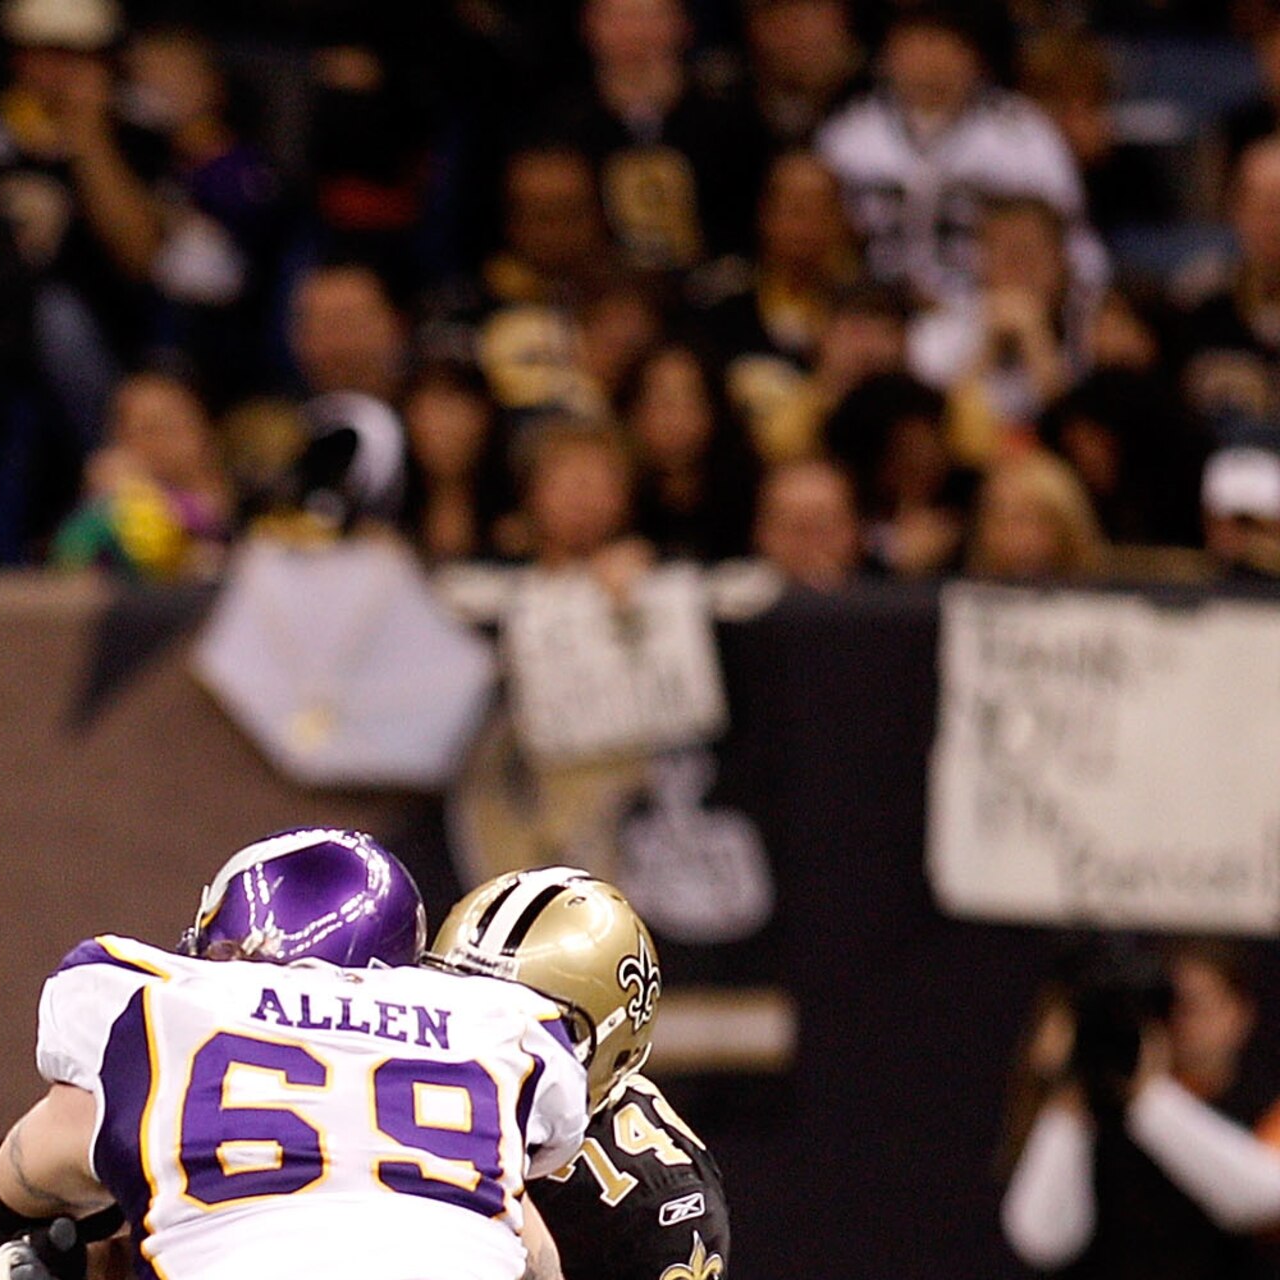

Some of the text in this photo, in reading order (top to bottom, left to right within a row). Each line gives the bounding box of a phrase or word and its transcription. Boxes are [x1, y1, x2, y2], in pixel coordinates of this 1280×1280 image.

[249, 986, 452, 1050] ALLEN
[177, 1027, 507, 1218] 69
[546, 1101, 693, 1208] 74
